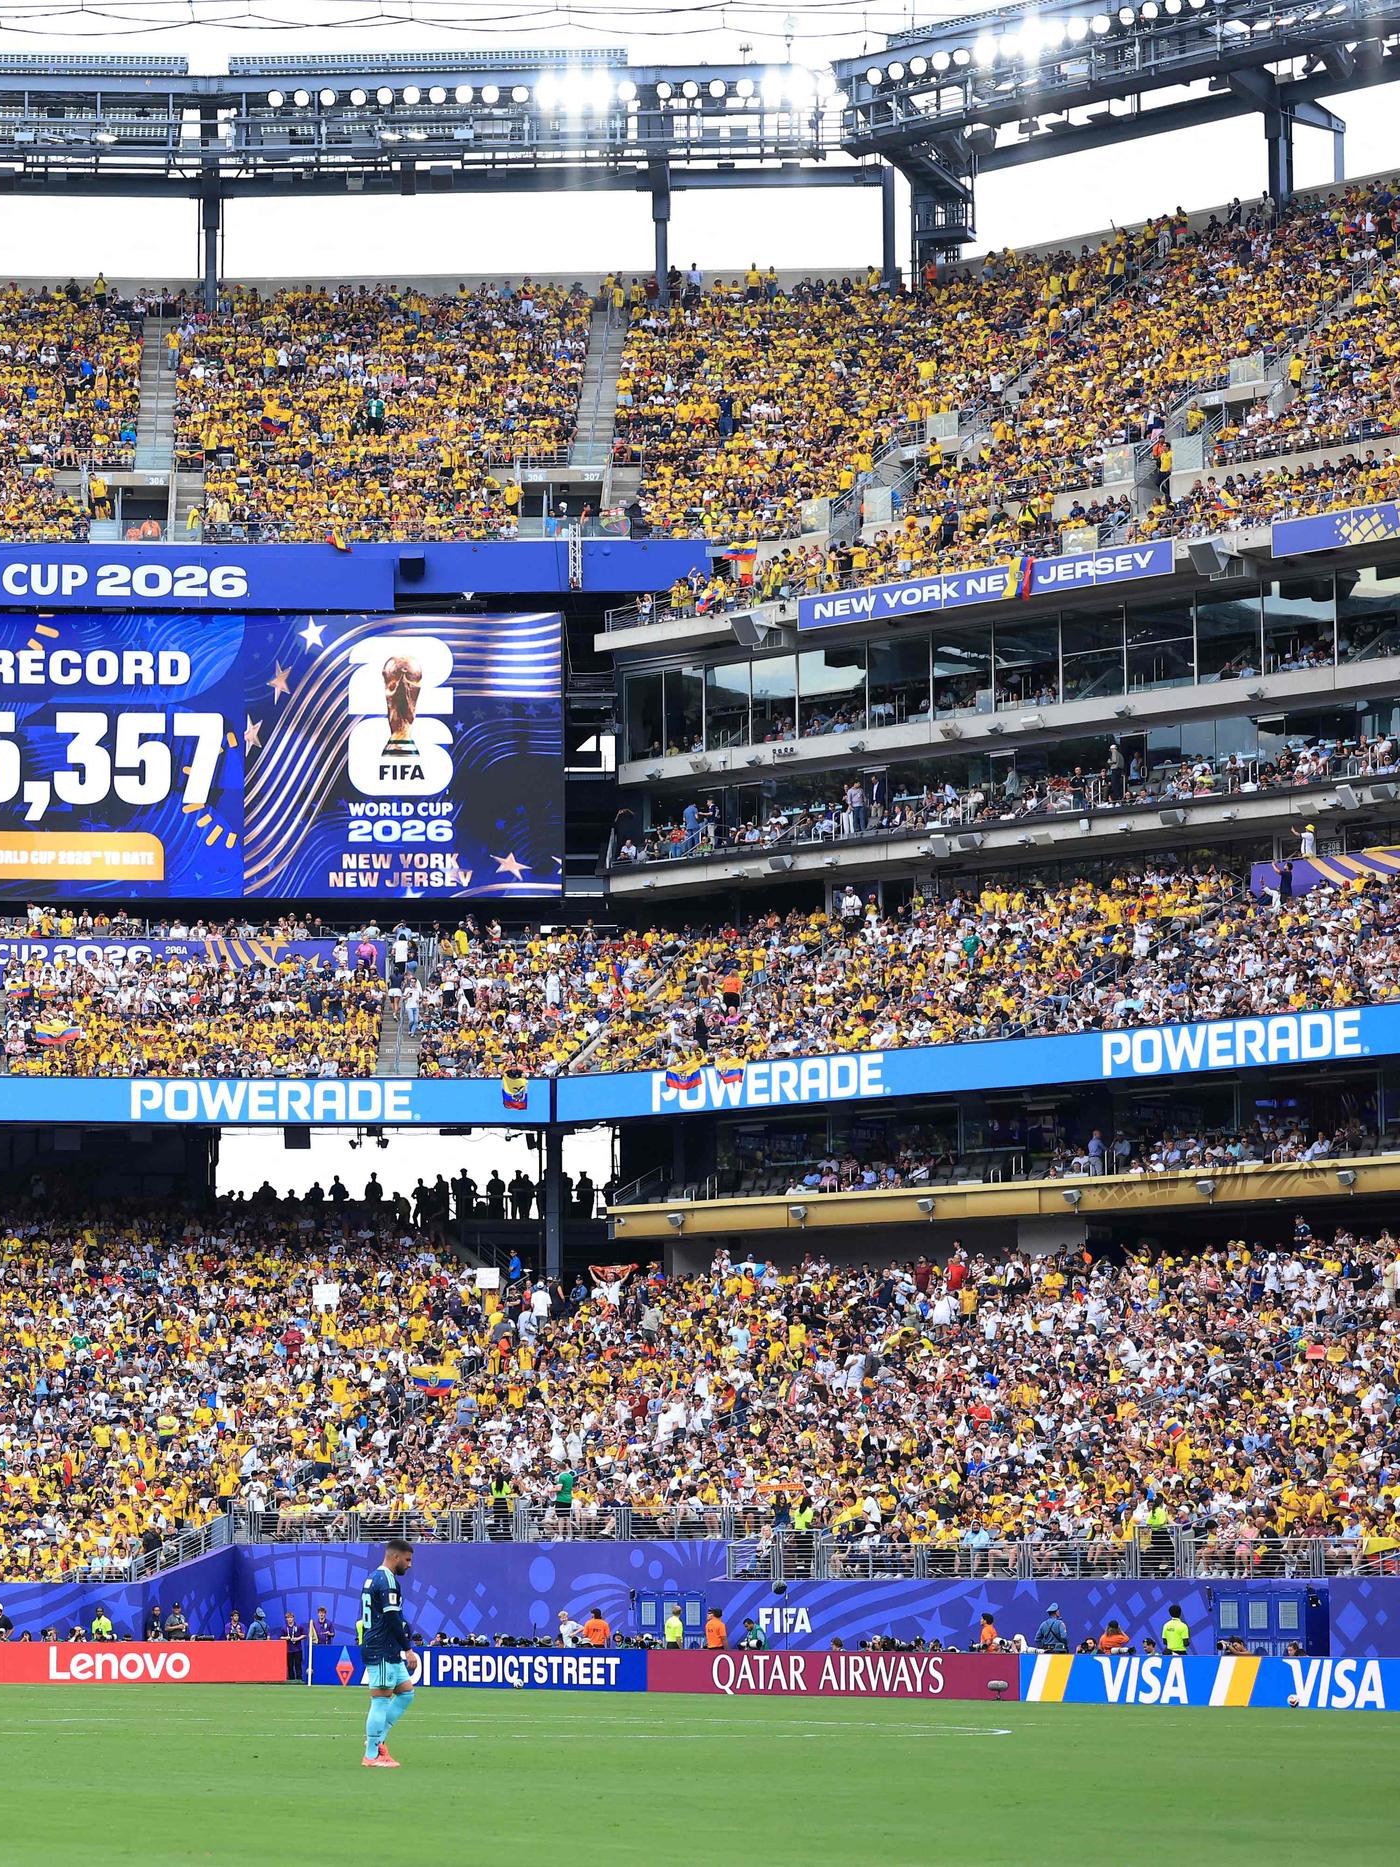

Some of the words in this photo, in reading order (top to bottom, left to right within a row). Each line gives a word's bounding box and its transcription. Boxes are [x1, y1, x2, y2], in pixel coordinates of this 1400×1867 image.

[149, 477, 164, 485] 306
[584, 473, 600, 481] 307
[1, 563, 90, 596] CUP
[95, 564, 248, 598] 2026
[813, 593, 877, 620] NEW
[883, 579, 960, 610] YORK
[966, 573, 1010, 597] NE
[1037, 550, 1155, 587] JERSEY
[378, 763, 425, 781] FIFA
[348, 801, 415, 817] WORLD
[417, 802, 453, 817] CUP
[348, 819, 453, 843] 2026
[30, 850, 57, 865] CUP
[104, 851, 120, 865] TO
[341, 853, 393, 869] NEW
[399, 853, 459, 870] YORK
[329, 871, 381, 888] NEW
[385, 870, 473, 888] JERSEY
[758, 1607, 813, 1634] FIFA
[48, 1646, 191, 1681] Lenovo
[438, 1654, 621, 1687] PREDICTSTREET
[711, 1654, 806, 1695] QATAR
[818, 1655, 945, 1695] AIRWAYS
[1093, 1656, 1189, 1705] VISA
[1282, 1658, 1386, 1710] VISA
